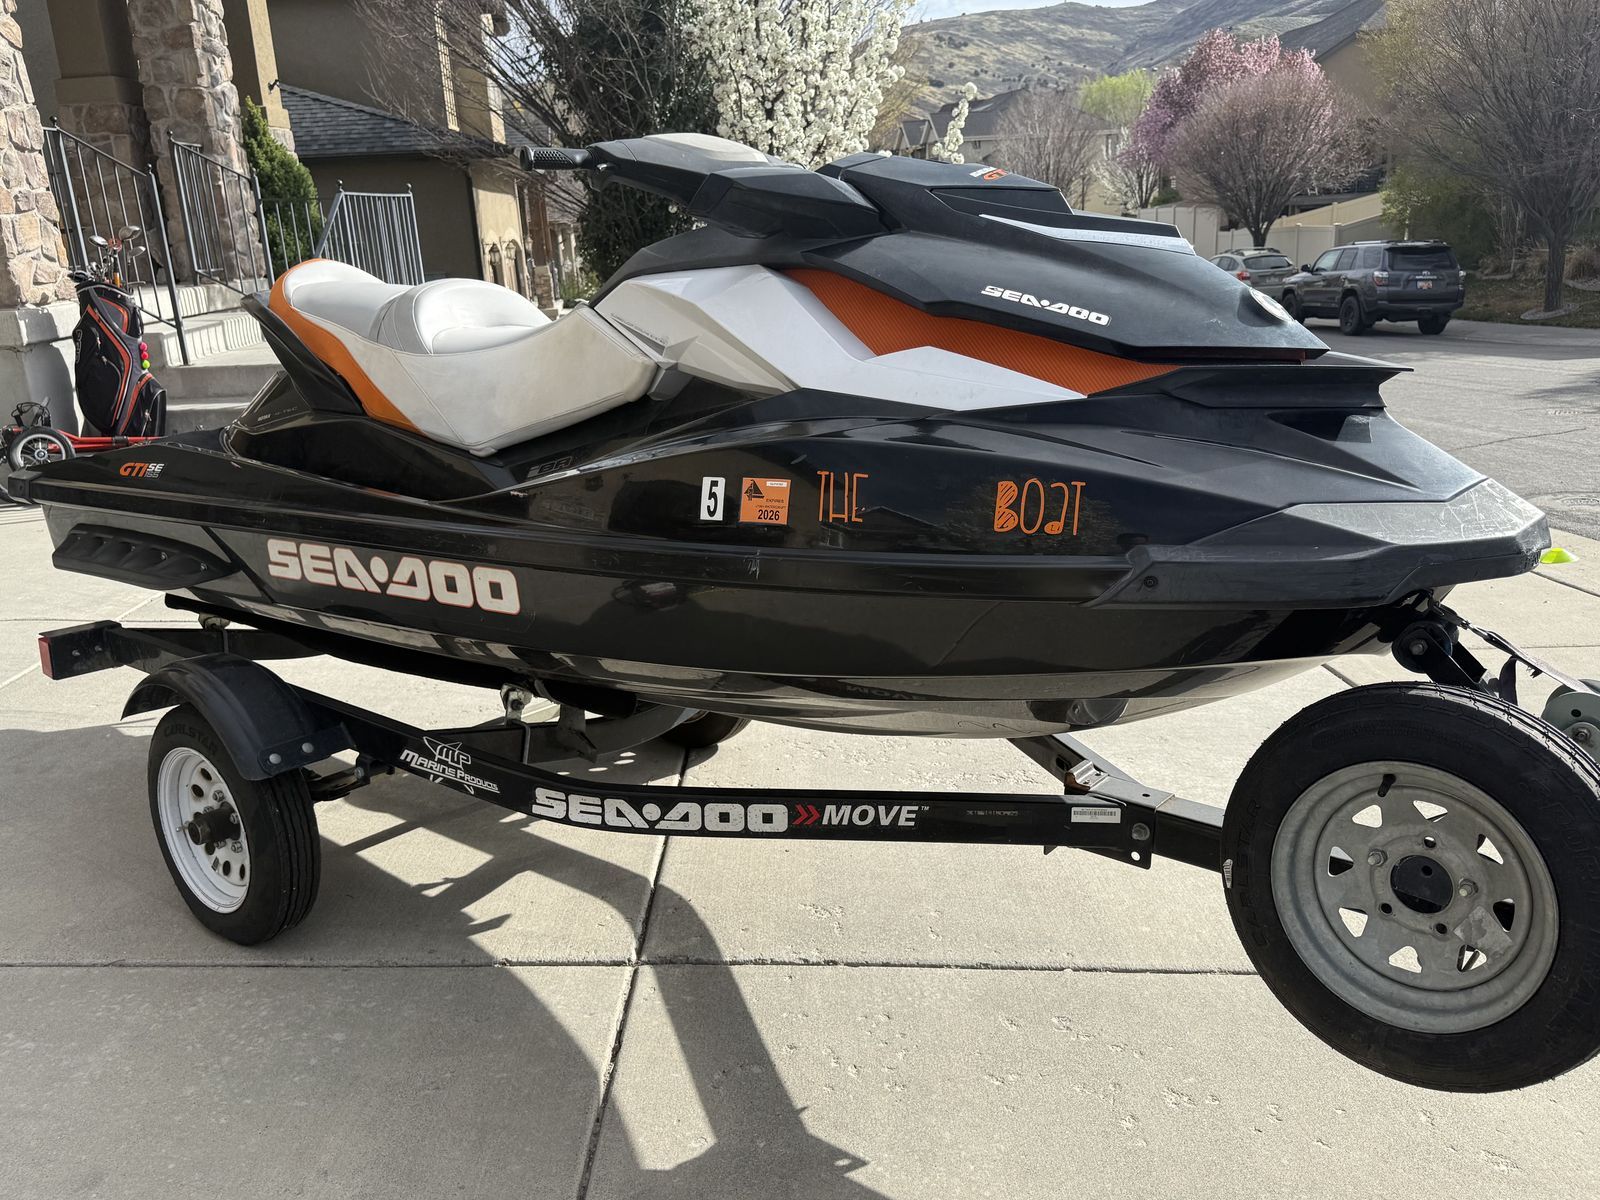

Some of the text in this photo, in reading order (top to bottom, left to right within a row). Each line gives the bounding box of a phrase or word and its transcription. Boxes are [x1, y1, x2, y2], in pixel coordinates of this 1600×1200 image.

[119, 462, 165, 477] GTI SE
[706, 479, 719, 518] 5
[816, 470, 869, 523] THE
[757, 509, 780, 521] 2026
[822, 804, 919, 826] MOVE
